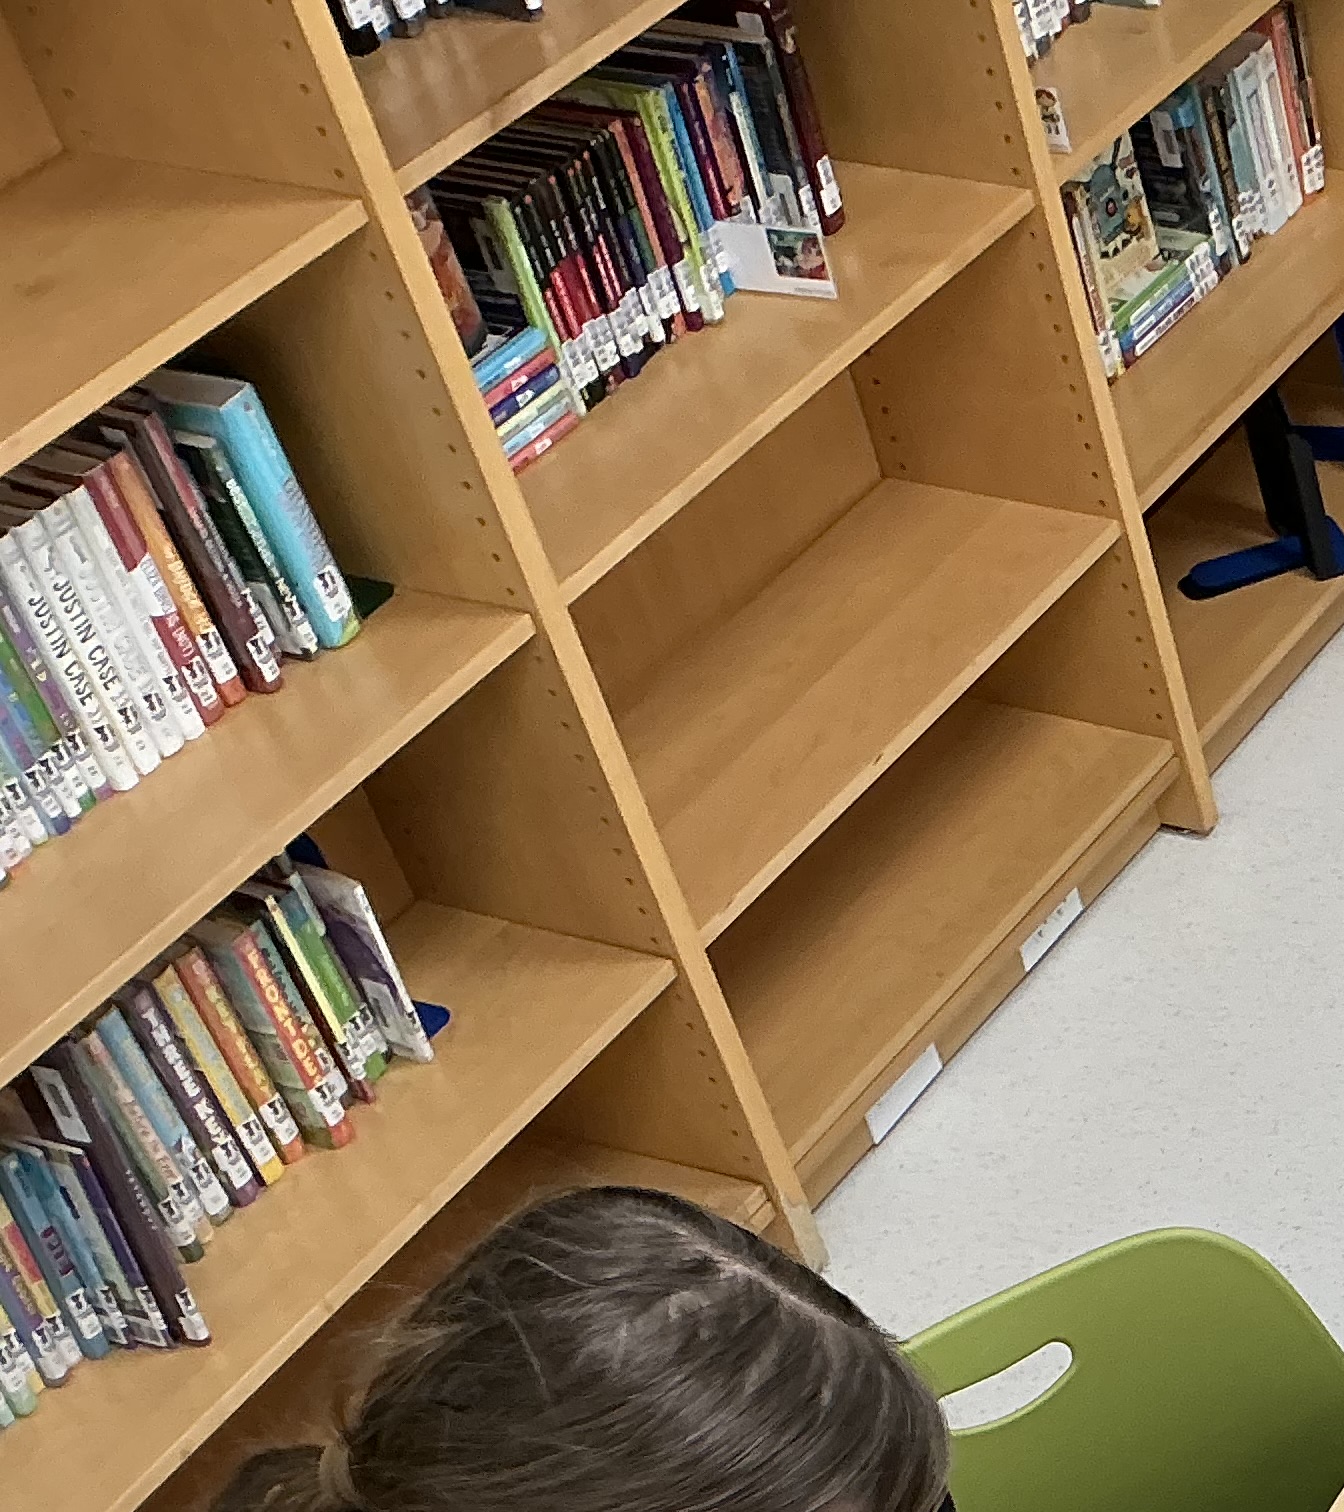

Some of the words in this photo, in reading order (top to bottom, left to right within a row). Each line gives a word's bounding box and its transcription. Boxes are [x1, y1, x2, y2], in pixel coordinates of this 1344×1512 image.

[26, 593, 72, 660] JUSTIN
[61, 659, 97, 707] CASE
[51, 577, 98, 643] JUSTIN
[85, 643, 122, 691] CASE
[289, 1036, 325, 1086] DE
[191, 1095, 231, 1147] KEY
